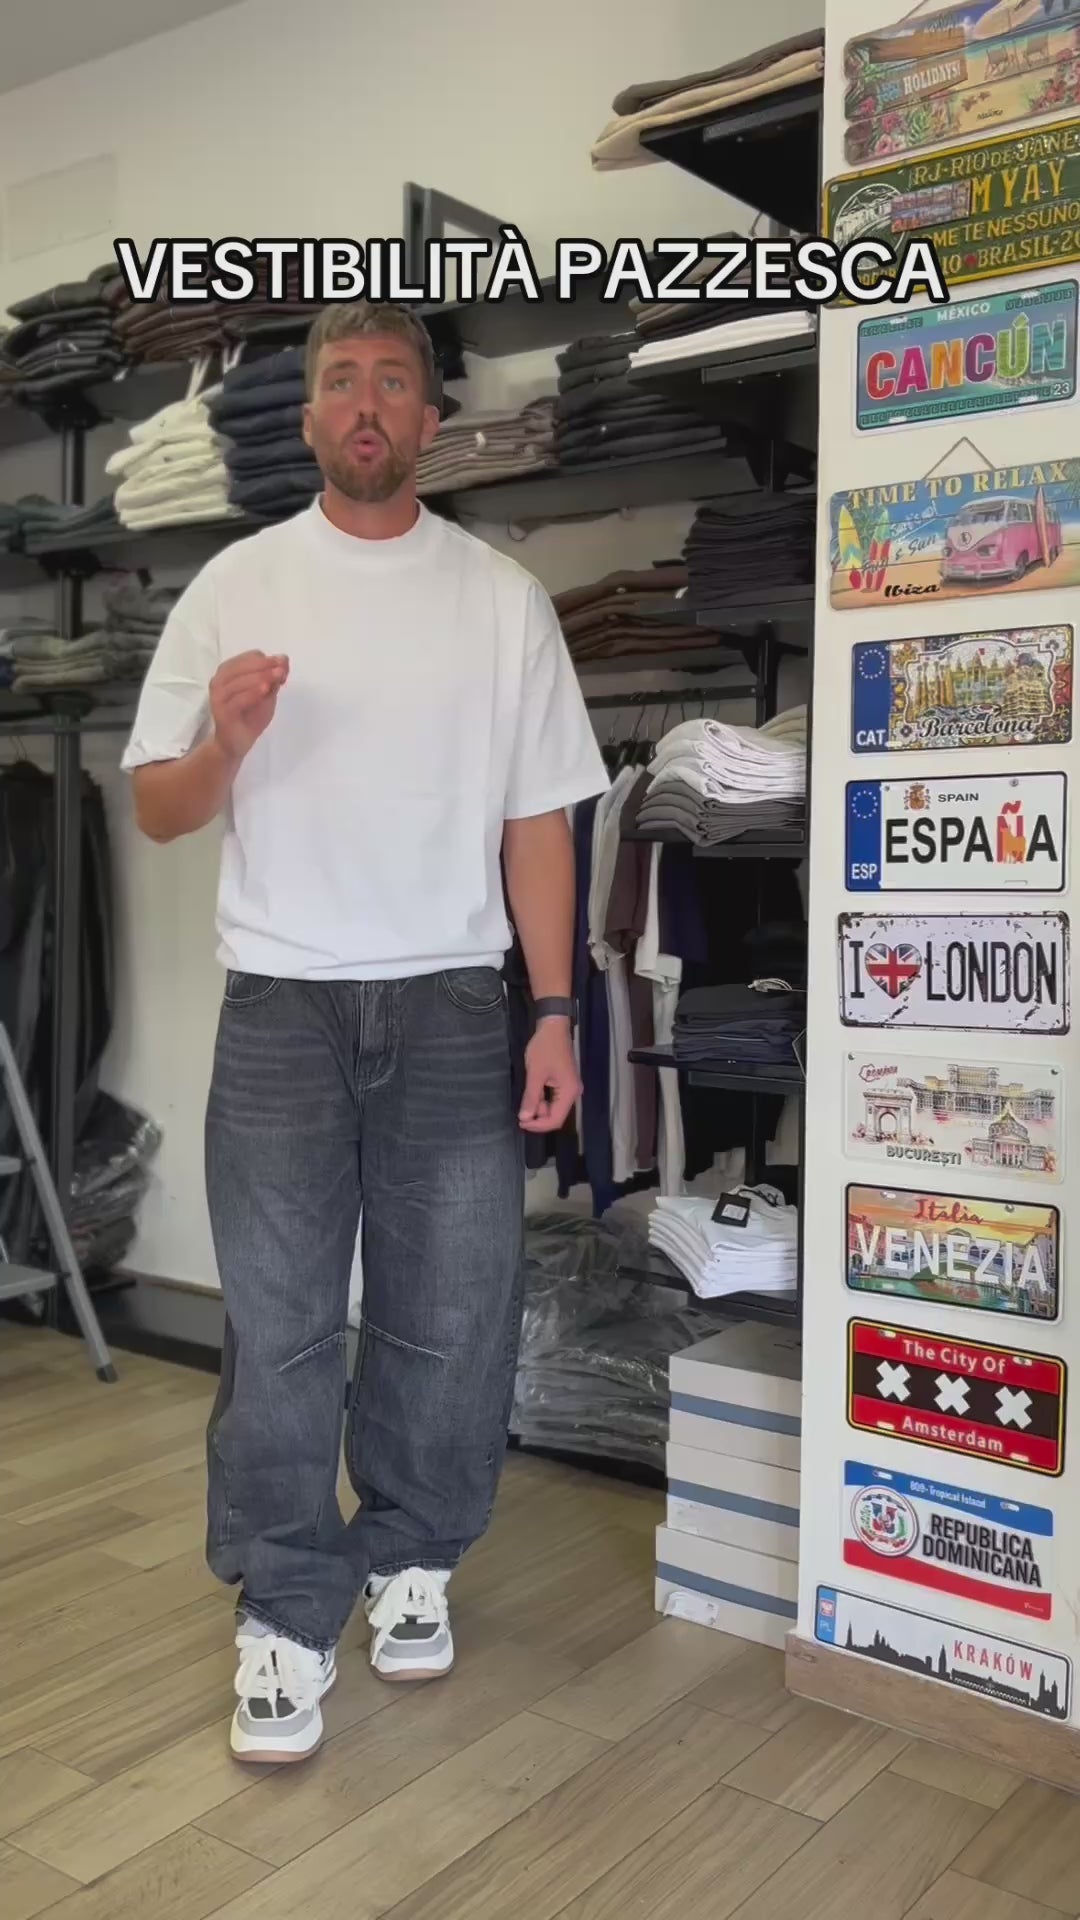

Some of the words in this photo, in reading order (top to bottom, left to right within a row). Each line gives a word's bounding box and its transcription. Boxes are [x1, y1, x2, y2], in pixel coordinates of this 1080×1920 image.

[991, 150, 1013, 167] DE
[1016, 130, 1075, 161] JANE
[987, 201, 1080, 238] NESSUNO
[1053, 383, 1070, 397] 23
[848, 483, 916, 510] TIME
[924, 477, 962, 498] TO
[973, 462, 1069, 493] RELAX
[884, 584, 940, 598] Ibiza
[856, 729, 886, 746] CAT
[919, 716, 1034, 738] Barcelona
[937, 793, 979, 803] SPAIN
[885, 800, 1058, 864] ESPAÑA
[851, 863, 877, 880] ESP
[849, 941, 865, 999] I
[925, 941, 1057, 1005] LONDON
[914, 1198, 984, 1224] Italia
[855, 1223, 1048, 1292] VENEZIA
[903, 1339, 936, 1361] The
[940, 1349, 978, 1373] City
[983, 1356, 1006, 1374] Of
[902, 1415, 1004, 1453] Amsterdam
[961, 1493, 986, 1509] Island
[930, 1513, 1035, 1562] REPUBLICA
[922, 1535, 1042, 1588] DOMINICANA
[954, 1639, 1034, 1681] KRAKÓW
